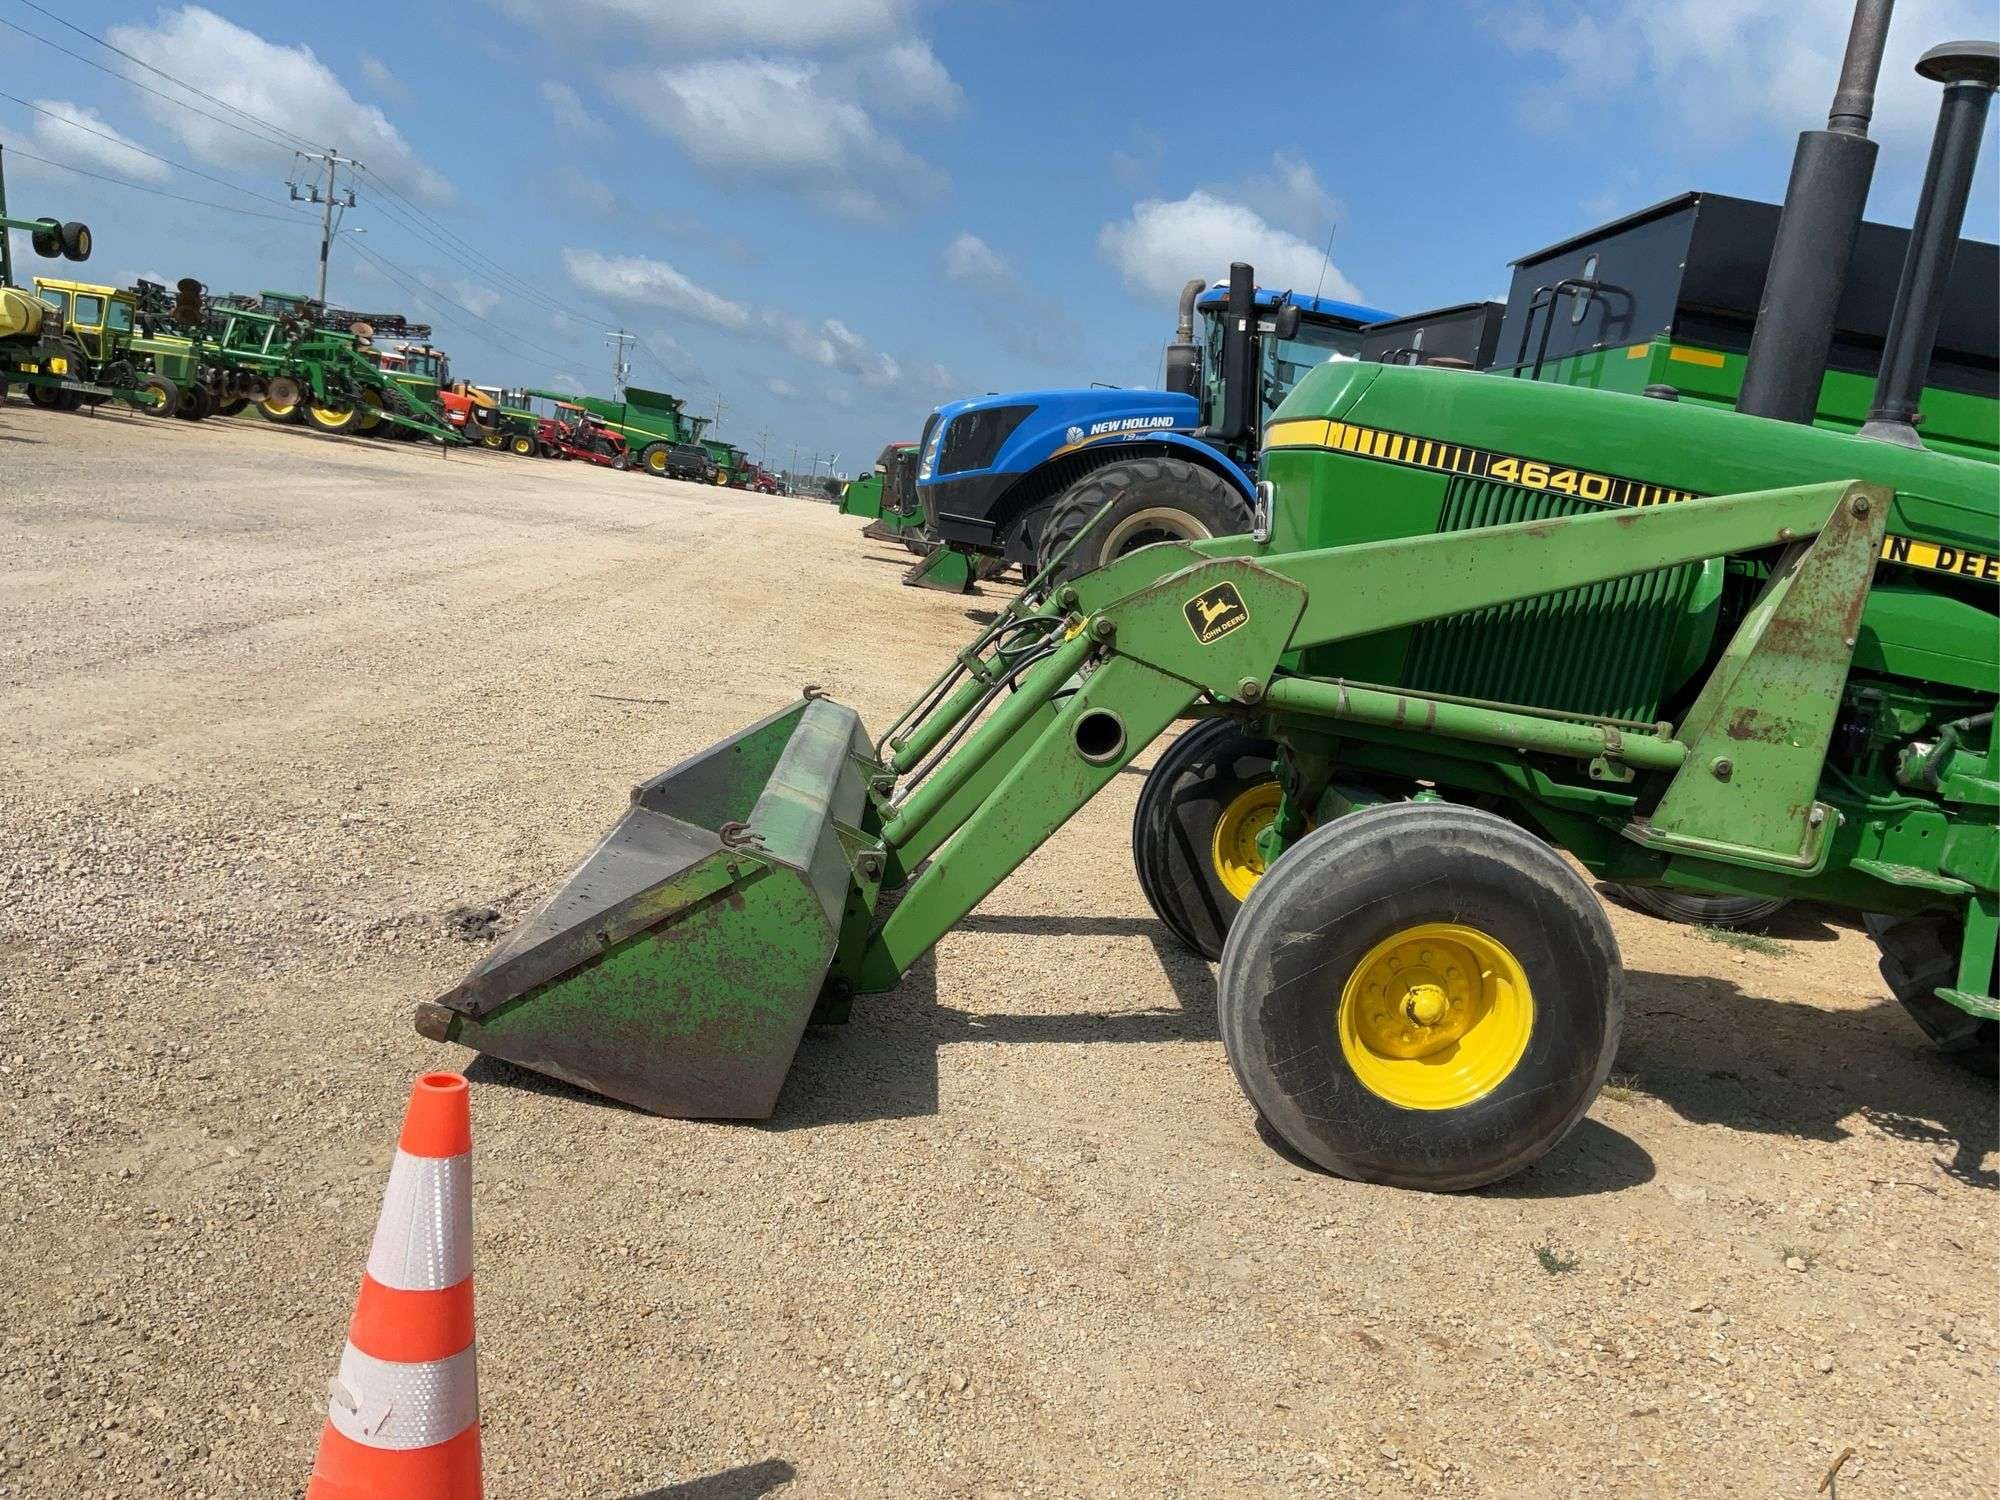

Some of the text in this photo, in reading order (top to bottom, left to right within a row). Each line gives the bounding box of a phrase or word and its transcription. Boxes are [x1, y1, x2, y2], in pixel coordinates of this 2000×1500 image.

[1090, 416, 1174, 435] NEW HOLLAND
[1490, 457, 1610, 501] 4640
[1935, 545, 2000, 580] DEE
[1202, 613, 1247, 642] JOHN DEERE
